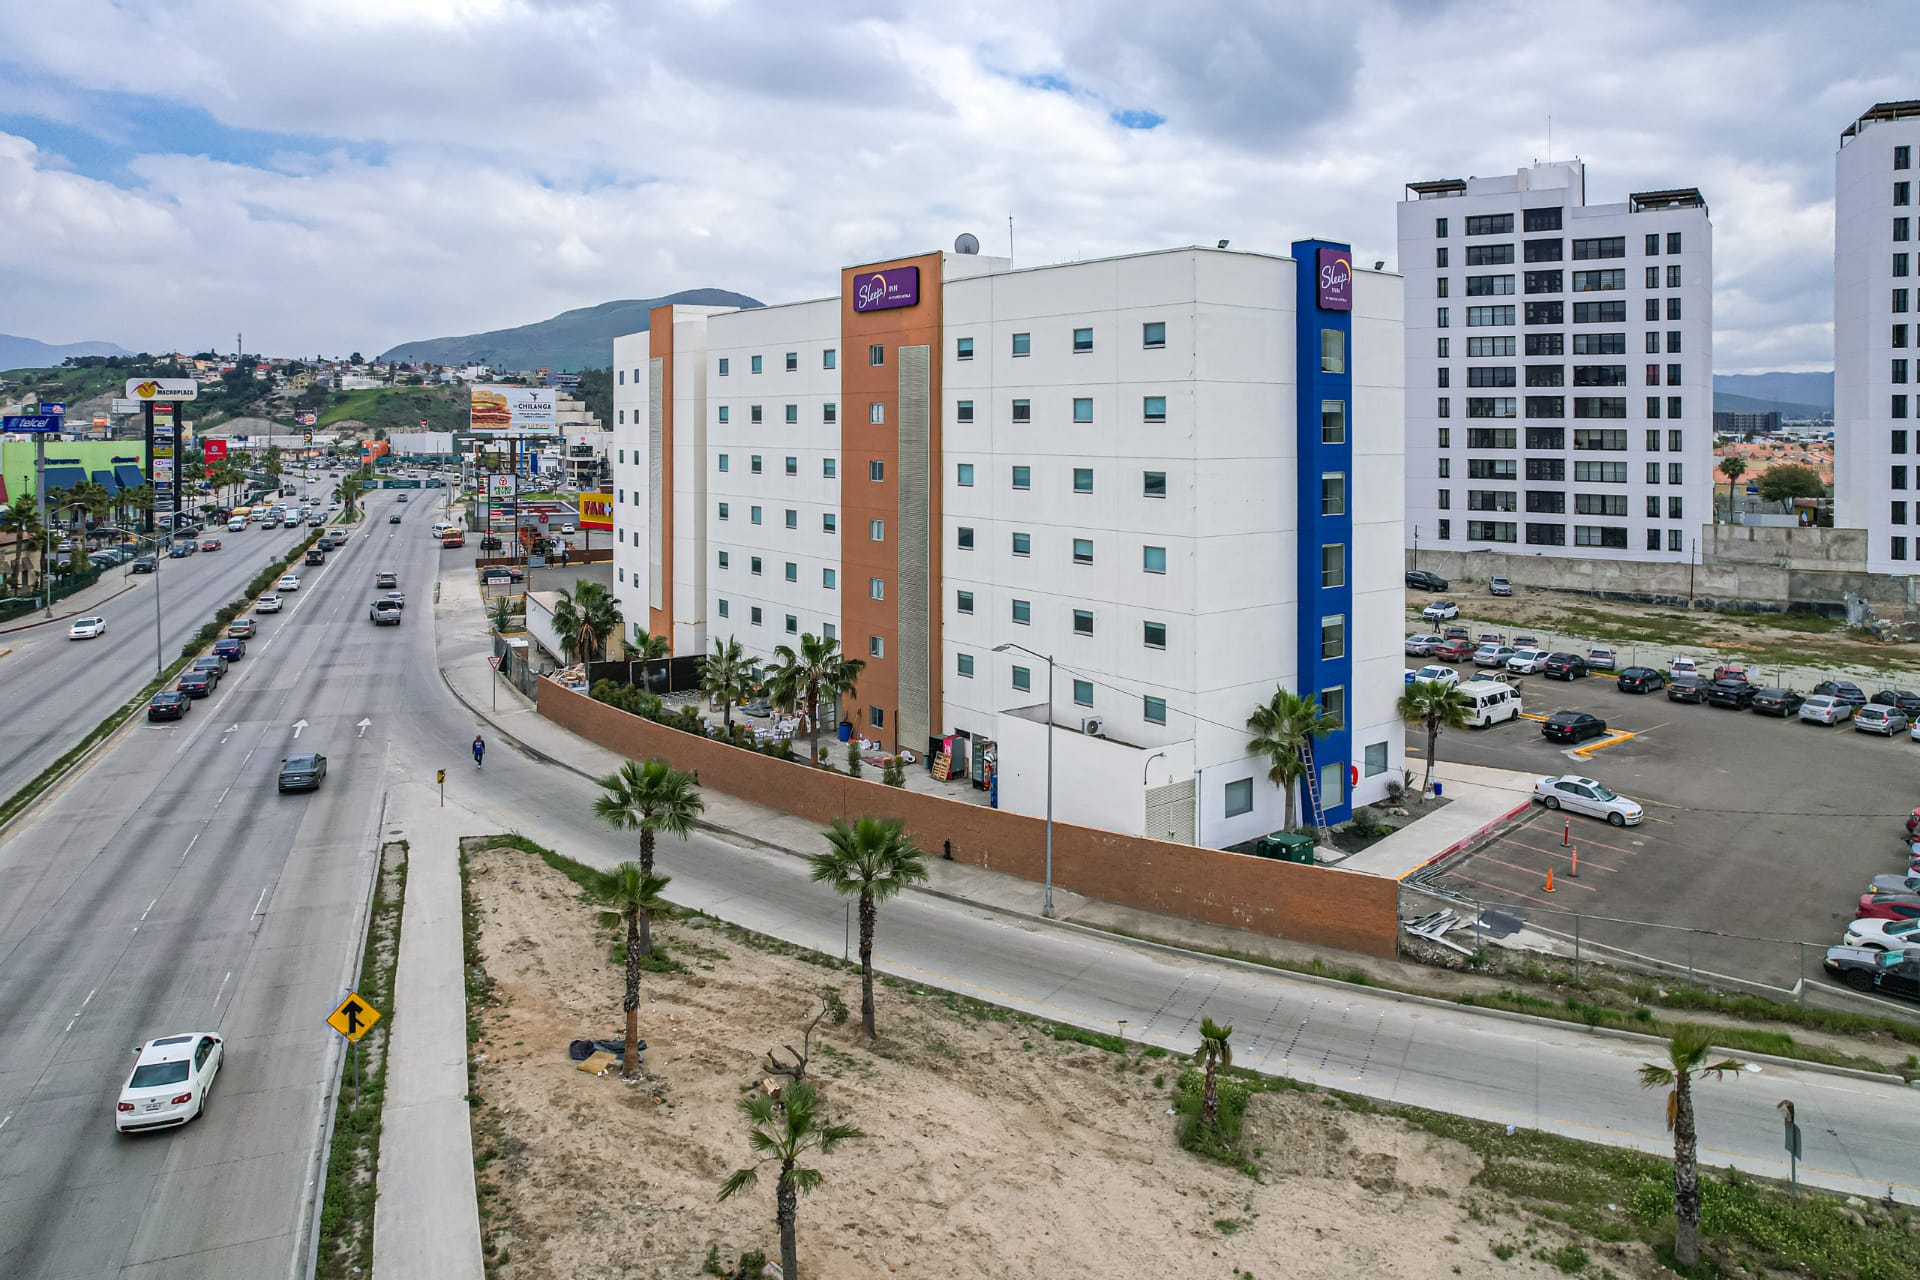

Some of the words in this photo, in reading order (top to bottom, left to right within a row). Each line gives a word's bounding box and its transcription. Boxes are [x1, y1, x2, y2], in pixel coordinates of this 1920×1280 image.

[1321, 265, 1349, 291] Sleep
[858, 283, 884, 309] Sleep
[19, 417, 50, 428] telcel
